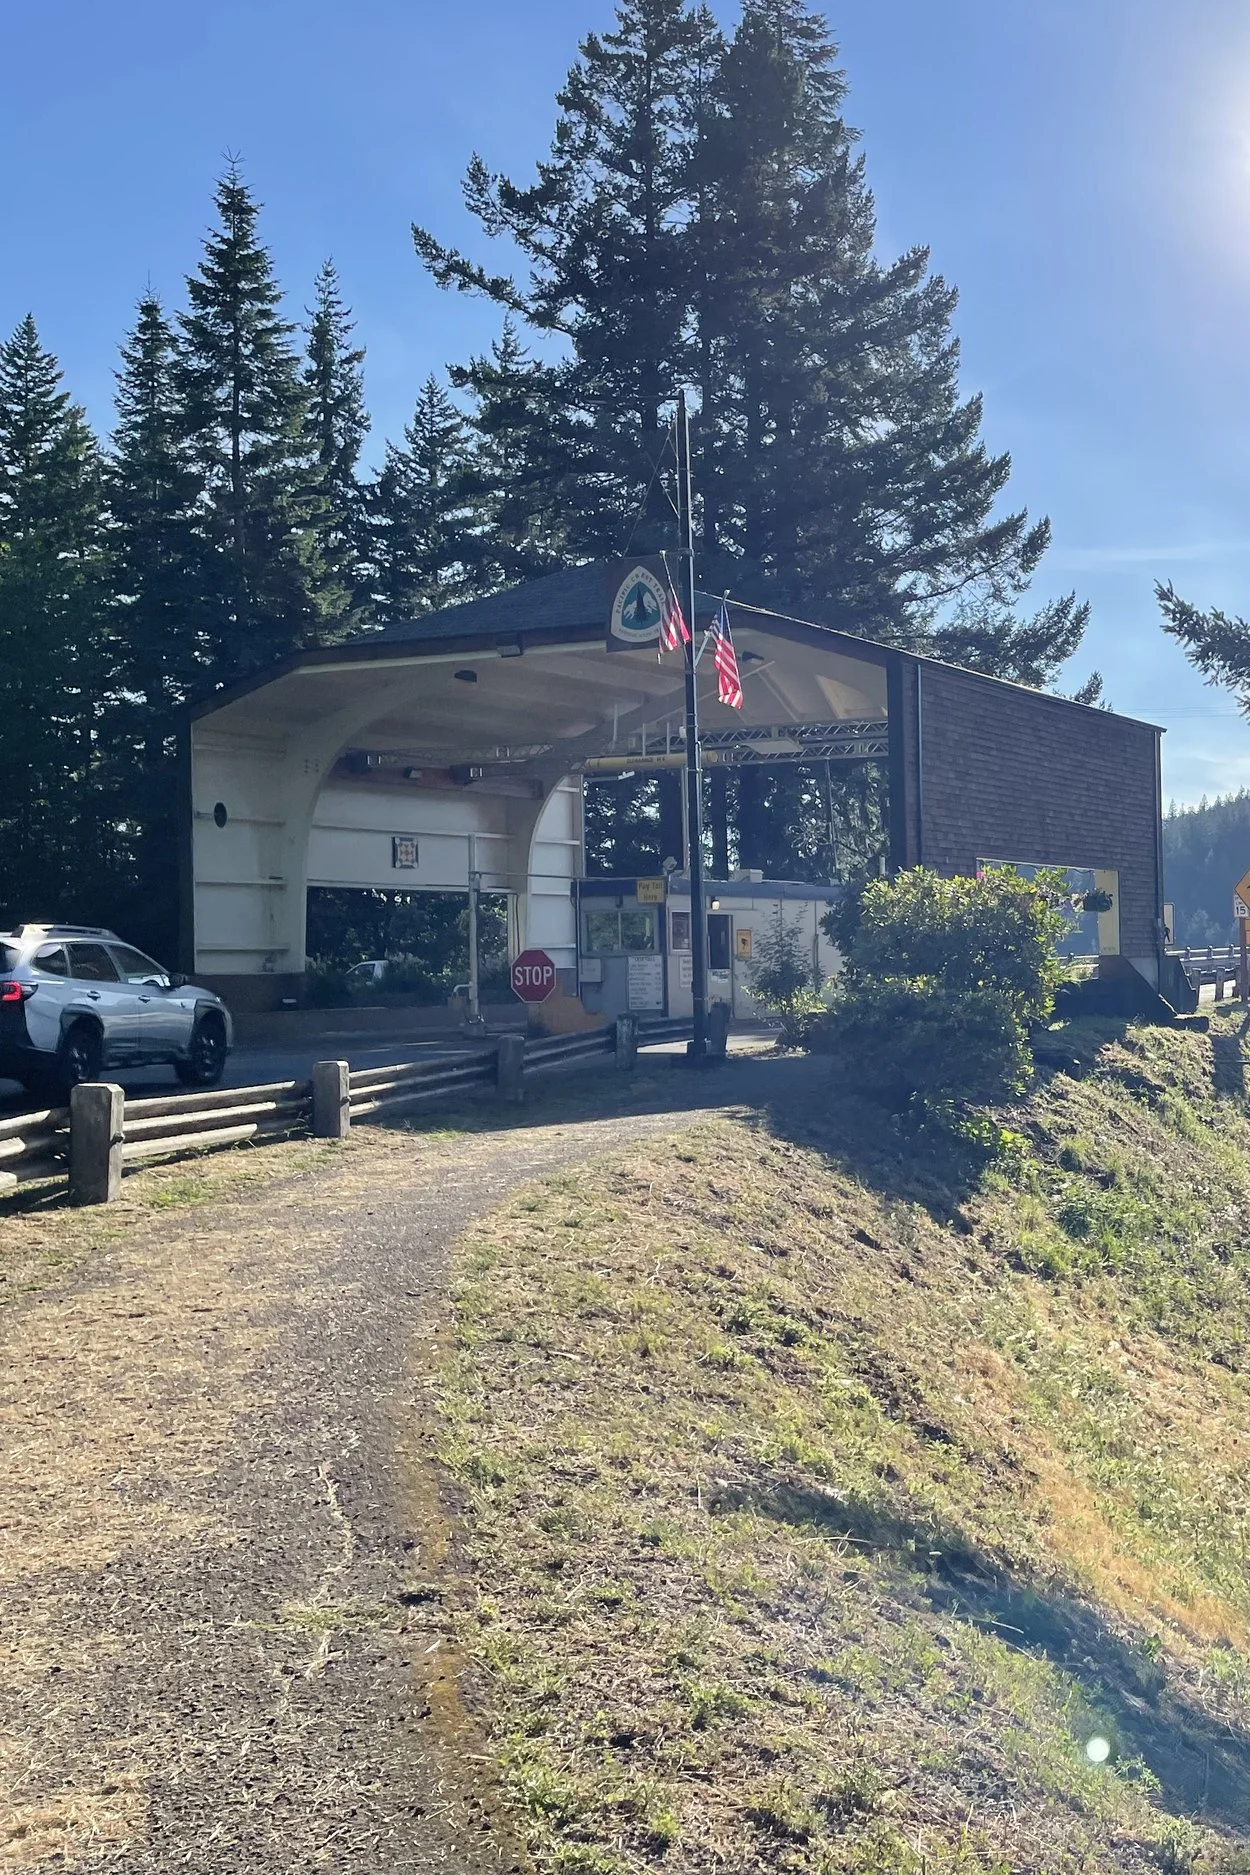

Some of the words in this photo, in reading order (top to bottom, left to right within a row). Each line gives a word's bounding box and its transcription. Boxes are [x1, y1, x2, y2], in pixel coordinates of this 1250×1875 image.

[616, 583, 632, 614] PACIFIC
[630, 572, 653, 583] CREST
[1236, 906, 1246, 915] 15
[514, 966, 553, 986] STOP
